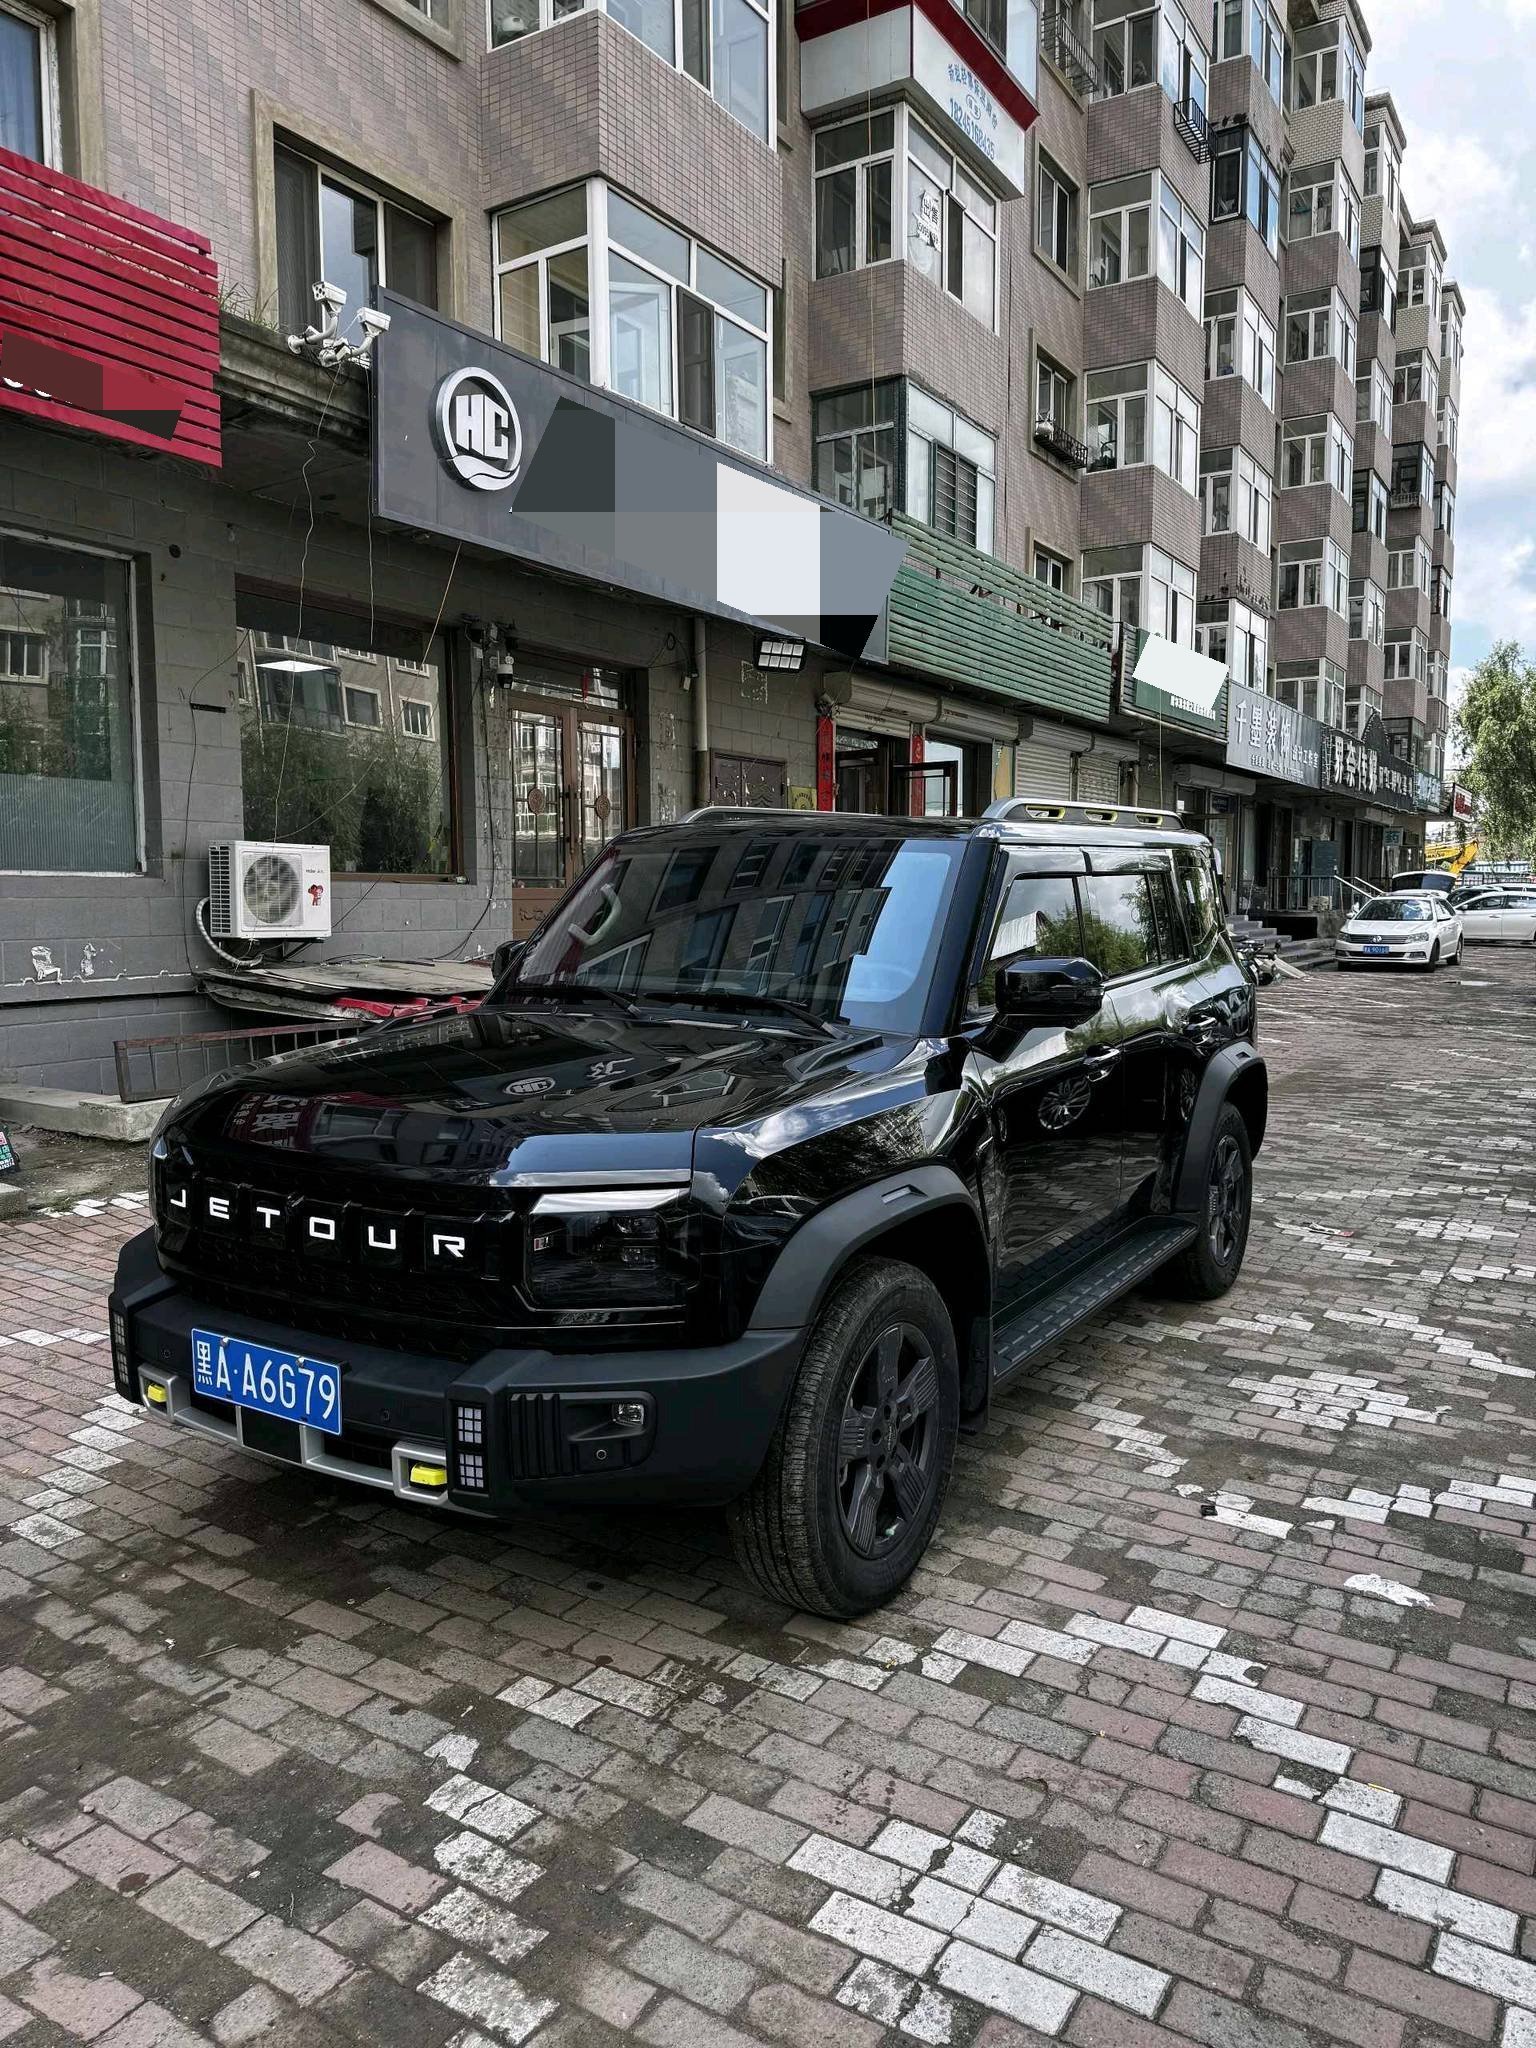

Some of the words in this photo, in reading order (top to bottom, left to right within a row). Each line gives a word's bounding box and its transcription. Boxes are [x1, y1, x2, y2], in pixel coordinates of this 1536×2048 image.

[922, 198, 939, 225] 出售
[455, 393, 509, 460] HC
[170, 1189, 465, 1258] JETOUR
